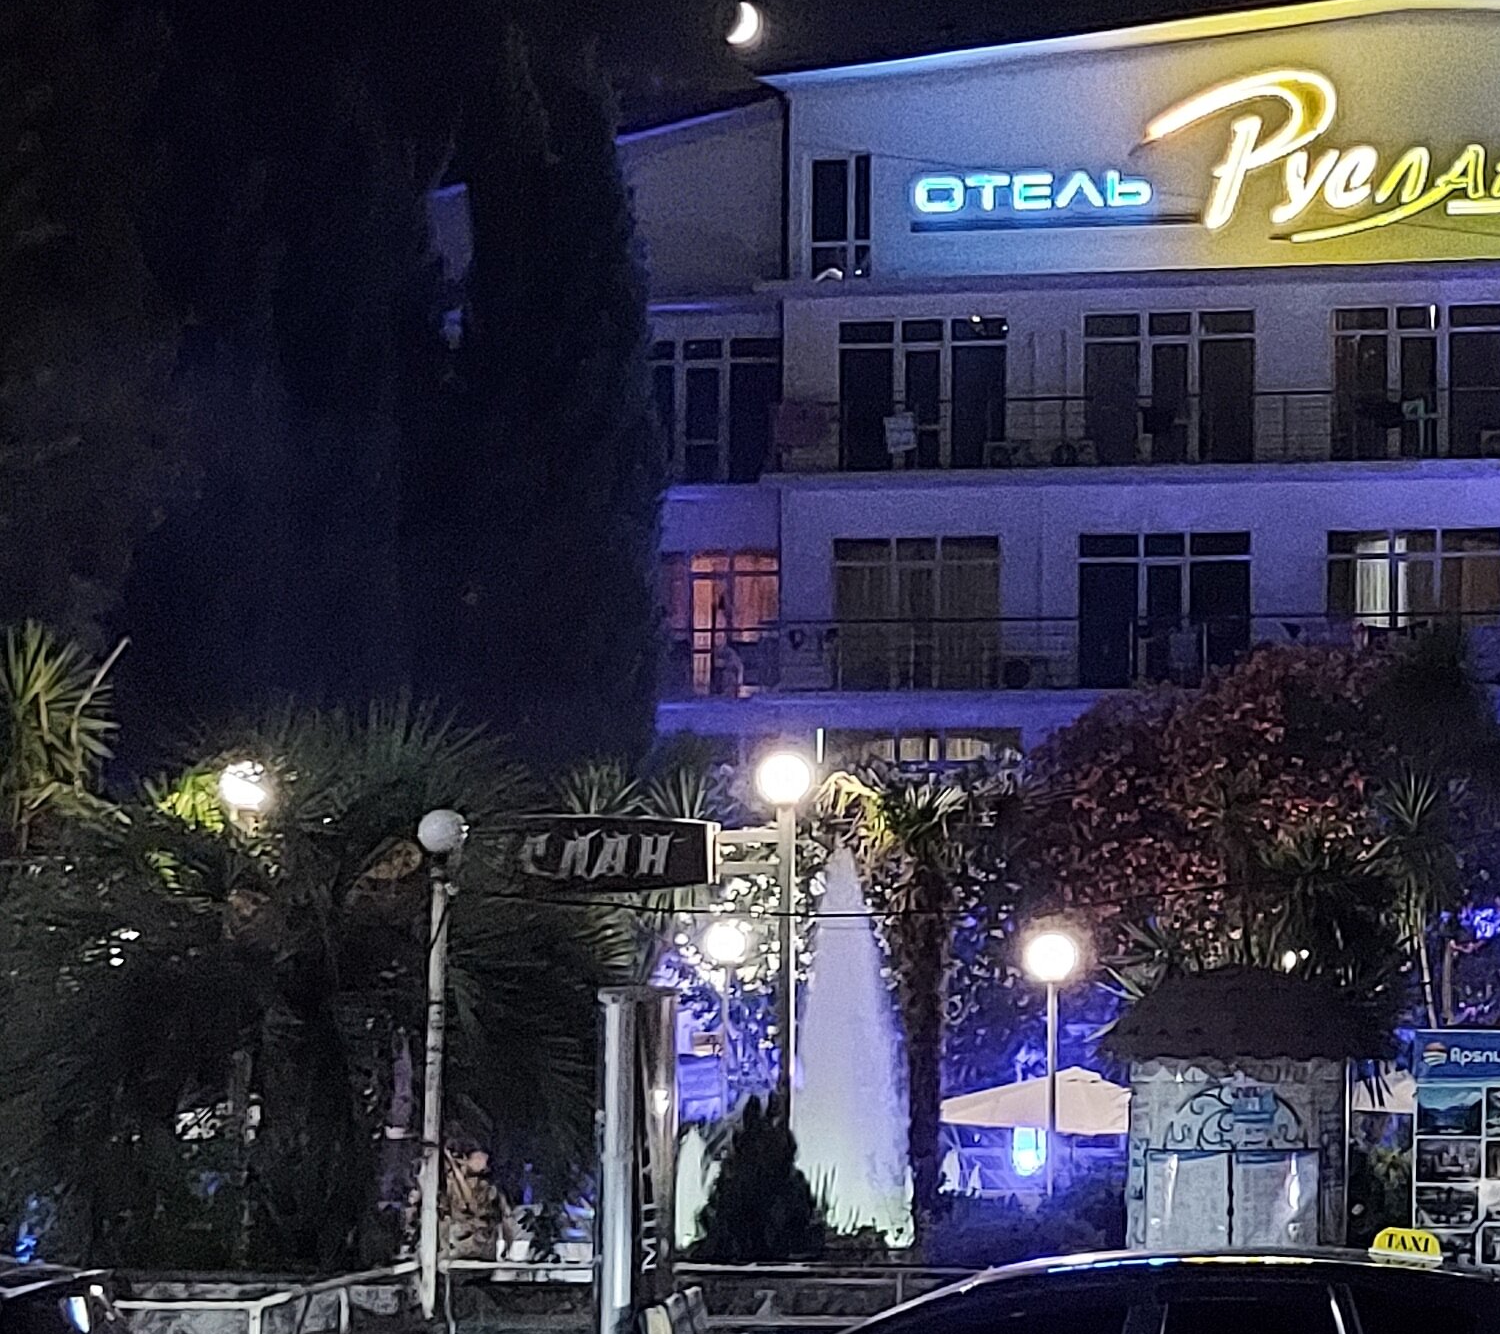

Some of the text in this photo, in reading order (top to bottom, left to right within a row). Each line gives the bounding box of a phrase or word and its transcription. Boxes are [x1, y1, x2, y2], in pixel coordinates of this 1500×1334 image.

[914, 169, 1153, 213] ОТЕЛЬ
[519, 828, 676, 880] СЛАН
[1384, 1233, 1430, 1252] TAXI
